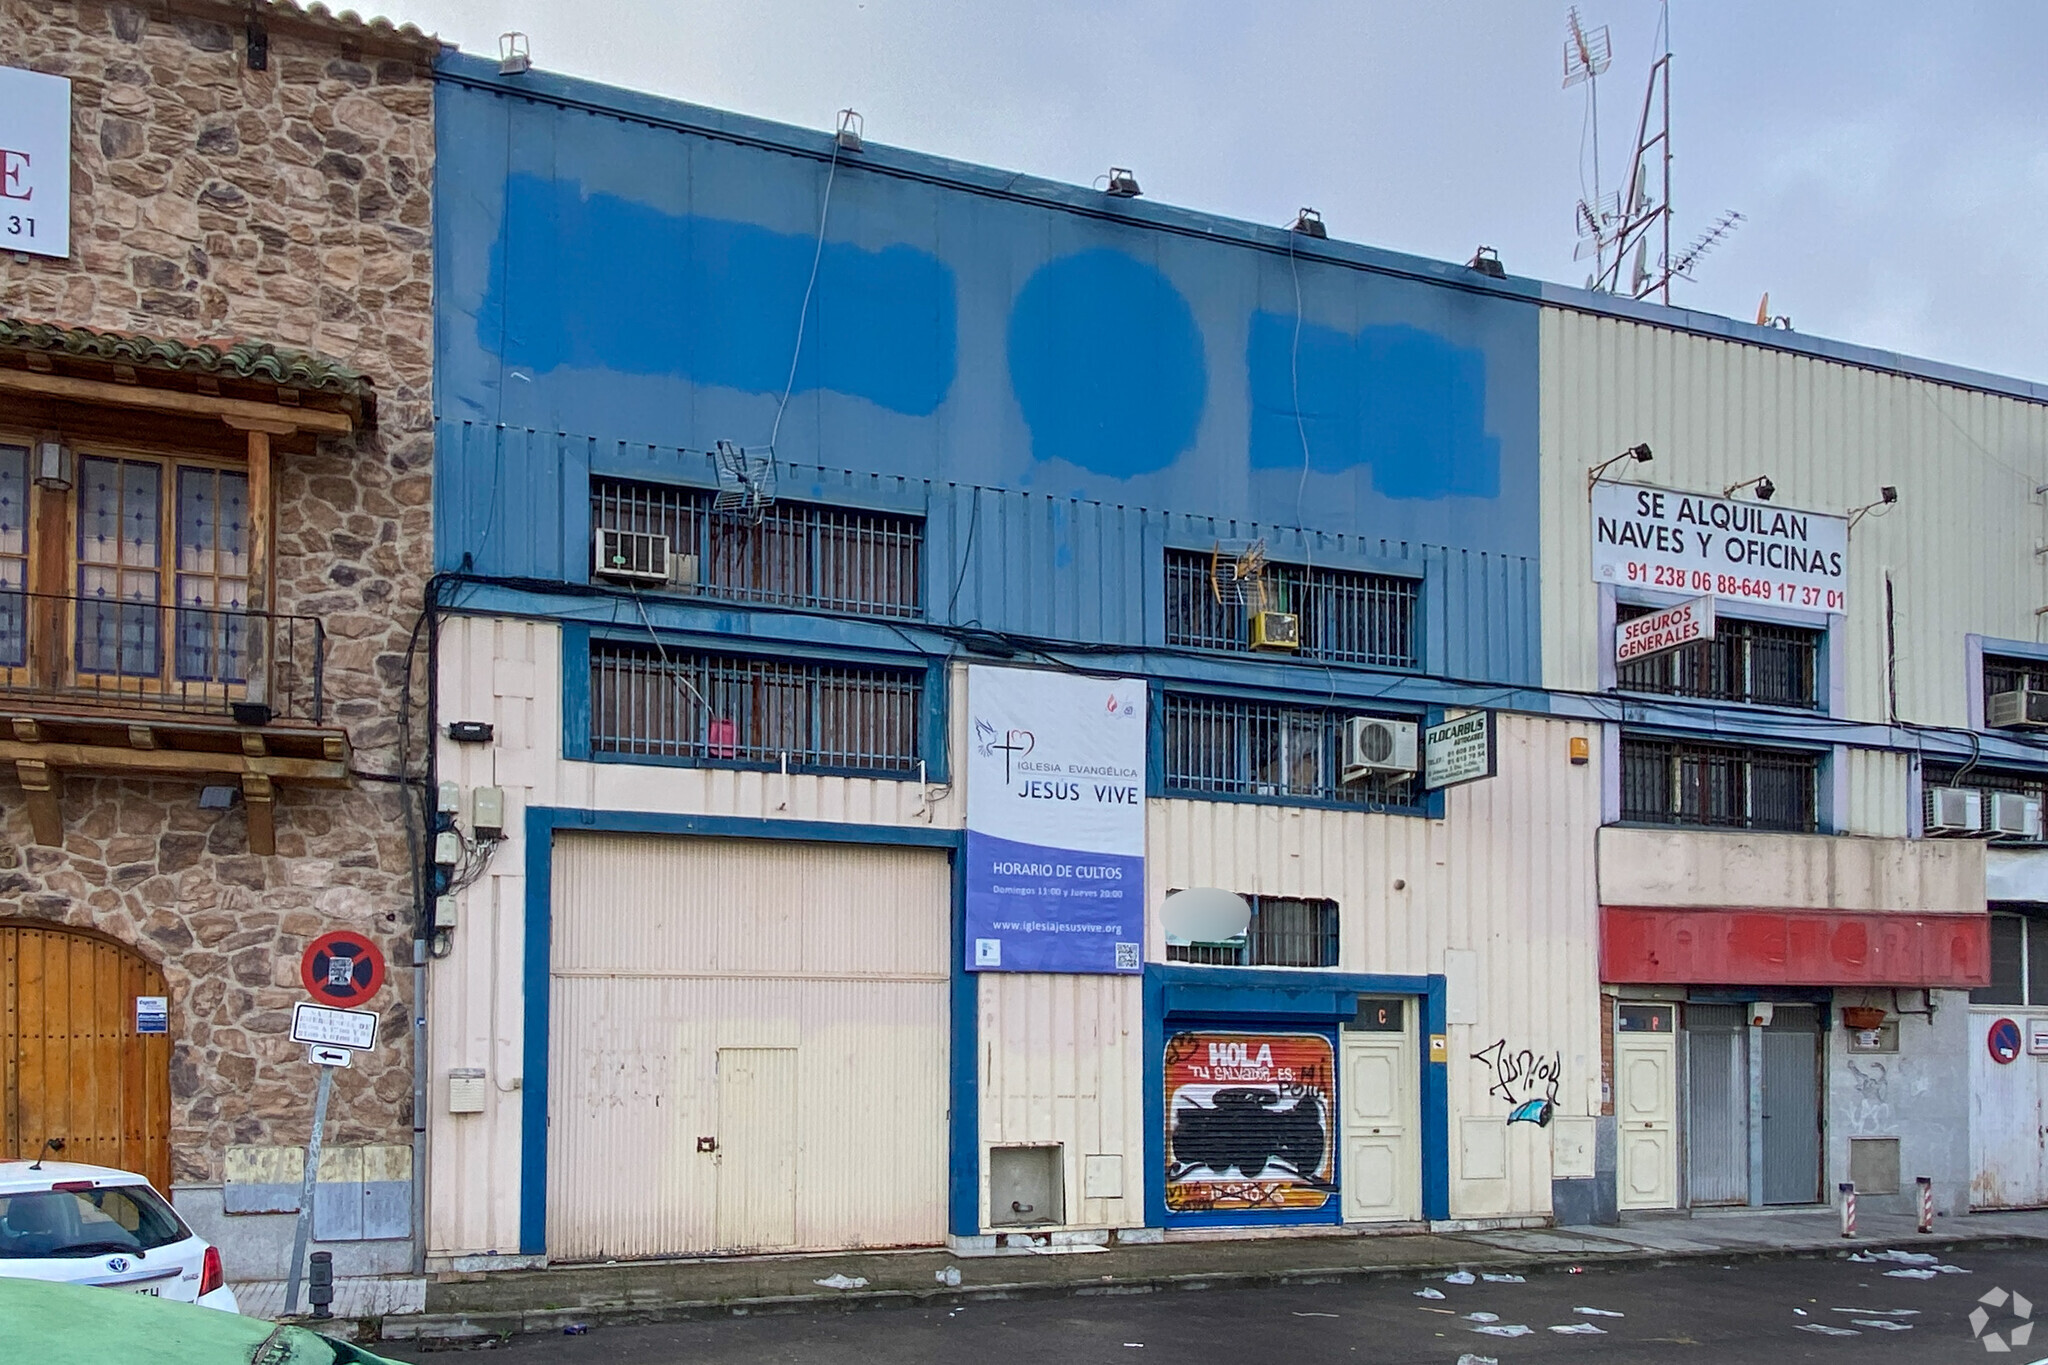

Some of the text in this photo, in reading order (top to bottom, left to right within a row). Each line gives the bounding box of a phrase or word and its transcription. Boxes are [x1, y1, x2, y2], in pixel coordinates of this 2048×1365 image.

[7, 215, 35, 238] 31
[1637, 490, 1807, 542] SE ALQUILAN
[1598, 517, 1842, 578] NAVES Y OFICINAS
[1627, 562, 1845, 610] 91 238 06 88-649 17 37 01
[1625, 606, 1692, 641] SEGUROS
[1618, 621, 1700, 658] GENERALES
[1427, 718, 1485, 746] FLOCARBUS
[1017, 761, 1138, 778] IGLESIA EVANGÉLICA
[1094, 785, 1138, 805] VIVE
[993, 862, 1122, 880] HORARIO DE CULTOS
[993, 885, 1036, 897] Domingos
[1063, 889, 1068, 897] y
[1070, 888, 1098, 898] Jueves
[1100, 889, 1123, 898] 20:00
[993, 920, 1122, 936] www.iglesiajesusvive.org
[1379, 1008, 1386, 1024] C
[1208, 1042, 1274, 1068] HOLA
[1188, 1065, 1210, 1080] TU
